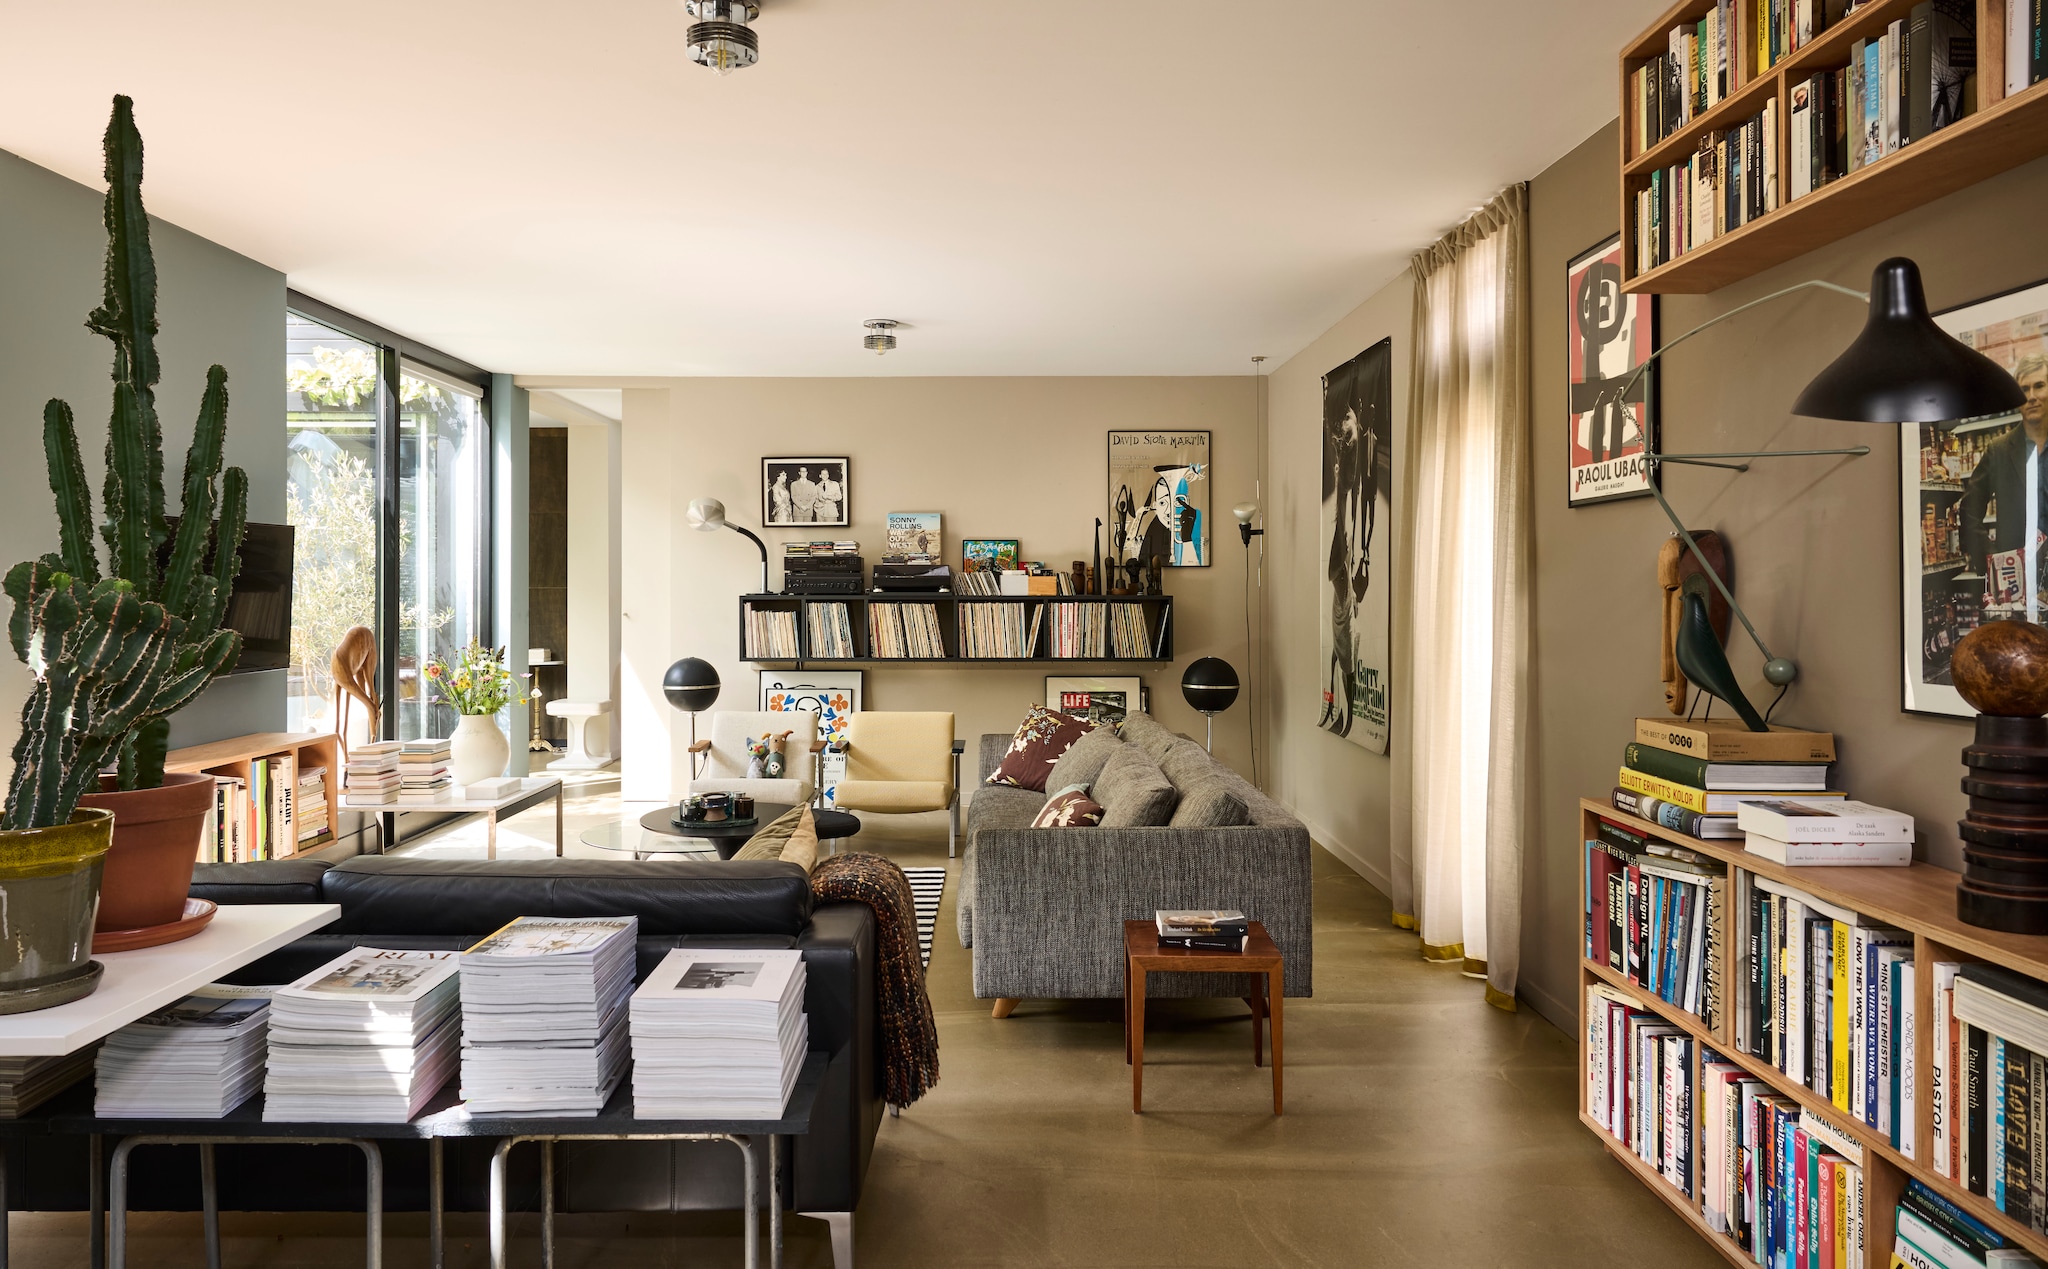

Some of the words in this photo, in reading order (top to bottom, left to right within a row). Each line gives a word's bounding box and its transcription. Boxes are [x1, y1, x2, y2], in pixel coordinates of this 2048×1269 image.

[2035, 28, 2041, 38] De
[2034, 39, 2042, 60] idioot
[1112, 434, 1140, 446] DAVID
[1143, 434, 1167, 446] STONE
[1170, 434, 1206, 449] MARTIN
[1578, 463, 1611, 485] RAOUL
[1614, 456, 1645, 479] UBAC
[2002, 556, 2020, 596] Brillo
[1357, 659, 1379, 688] Garry
[1063, 694, 1090, 707] LIFE
[1640, 729, 1648, 737] THE
[1621, 772, 1642, 787] ELLIOTT
[1643, 779, 1671, 799] ERWITT'S
[1673, 789, 1693, 806] KOLOR
[1795, 826, 1810, 834] JOËL
[1628, 880, 1637, 896] 8
[1640, 878, 1648, 920] Design
[1641, 921, 1648, 938] NL
[1679, 920, 1687, 962] INDUSTRIAL
[1787, 908, 1797, 963] JASPER
[1712, 887, 1721, 1037] VANFLETEREN
[1880, 962, 1888, 992] MING
[1868, 984, 1876, 1024] WHERE
[1868, 1024, 1876, 1045] WE
[1880, 995, 1888, 1077] STYLEMEISTER
[1904, 1012, 1914, 1056] NORDIC
[1969, 1047, 1979, 1073] Paul
[1904, 1058, 1914, 1100] MOODS
[1969, 1074, 1979, 1109] Smith
[1996, 1038, 2004, 1117] ALLEMAAL
[2033, 1062, 2041, 1099] HANNELORE
[1932, 1065, 1941, 1139] PASTOE
[1950, 1082, 1958, 1120] Schlegel
[2033, 1100, 2041, 1121] KNUTS
[1806, 1109, 1831, 1130] HUMAN
[2006, 1084, 2026, 1151] LOVE
[1777, 1114, 1785, 1176] Wallpaper
[1996, 1129, 2004, 1183] MENSEN
[2034, 1132, 2042, 1185] ULTRAMEGALORE
[1797, 1177, 1805, 1228] Fashionable
[1939, 1211, 1954, 1225] STYLE
[1797, 1231, 1805, 1257] Selby
[1810, 1227, 1818, 1254] Selby
[1846, 1216, 1854, 1241] living
[1953, 1234, 1970, 1248] STORAGE
